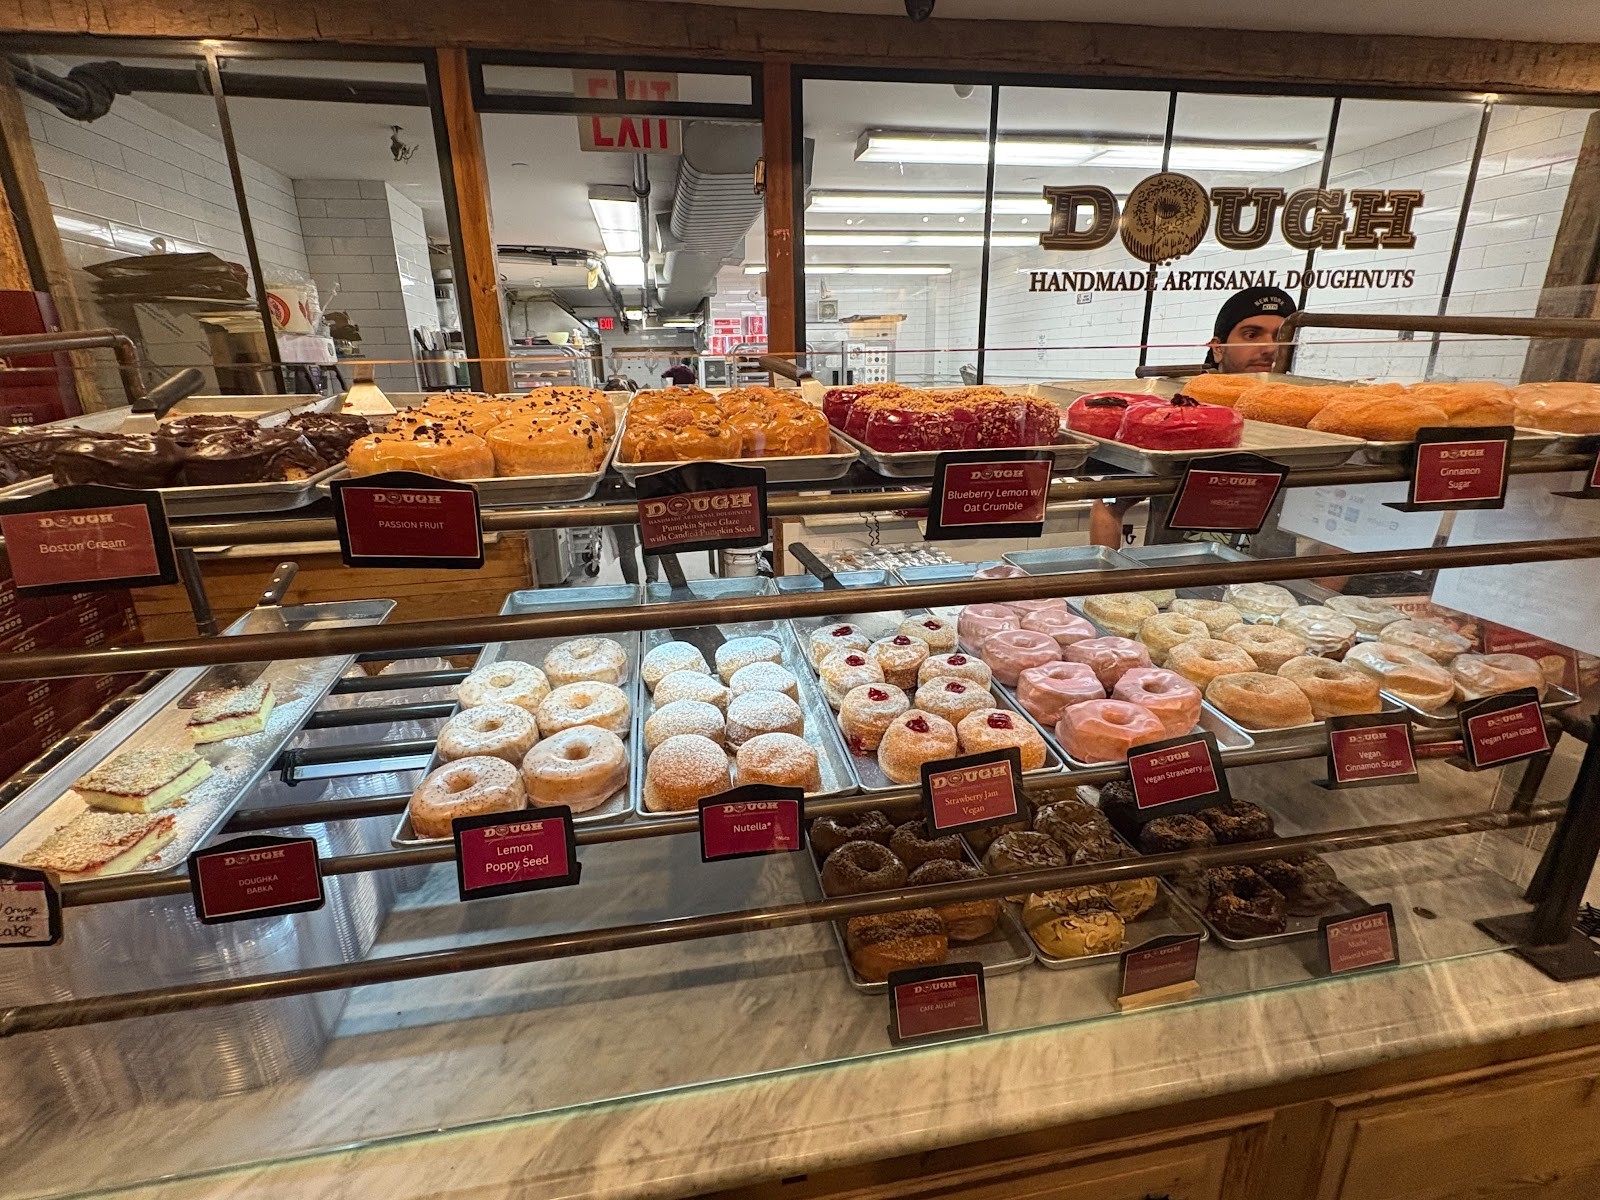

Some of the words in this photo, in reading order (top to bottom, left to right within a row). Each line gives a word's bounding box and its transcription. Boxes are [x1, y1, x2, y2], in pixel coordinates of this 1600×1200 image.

[1039, 172, 1425, 265] DOUGH
[1029, 271, 1158, 292] HANDMADE
[1162, 270, 1281, 291] ARTISANAL
[1284, 269, 1416, 290] DOUGHNUTS
[1254, 297, 1269, 306] NEW
[1270, 296, 1285, 306] YORK
[600, 318, 614, 330] EXIT
[1440, 449, 1485, 459] DOUGH
[970, 469, 1024, 480] DOUGH
[1440, 467, 1481, 477] Cinnamon
[1208, 476, 1258, 486] DOUGH
[1448, 480, 1471, 490] Sugar
[373, 492, 441, 504] DOUGH
[948, 489, 994, 500] Blueberry
[996, 488, 1028, 498] Lemon
[1030, 487, 1043, 497] w/
[644, 492, 753, 518] DOUGH
[963, 503, 980, 512] Oat
[983, 502, 1023, 511] Crumble
[38, 513, 114, 528] DOUGH
[379, 520, 418, 529] PASSION
[420, 521, 444, 530] FRUIT
[662, 522, 697, 533] Pumpkin
[698, 520, 717, 530] Spice
[718, 518, 740, 526] Glaze
[650, 533, 667, 543] with
[668, 530, 699, 541] Candied
[700, 527, 734, 537] Pumpkin
[734, 525, 756, 533] Seeds
[39, 542, 84, 554] Boston
[86, 538, 126, 549] Cream
[1480, 736, 1501, 746] Vegan
[1502, 731, 1519, 741] Plain
[1519, 726, 1537, 736] Glaze
[1359, 751, 1381, 760] Vegan
[1345, 762, 1380, 772] Cinnamon
[1381, 760, 1403, 768] Sugar
[933, 765, 1007, 789] DOUGH
[1144, 773, 1165, 784] Vegan
[1166, 766, 1203, 779] Strawberry
[945, 792, 983, 806] Strawberry
[984, 789, 999, 800] Jam
[723, 801, 779, 814] DOUGH
[963, 805, 985, 816] Vegan
[483, 822, 544, 838] DOUGH
[497, 843, 533, 856] Lemon
[224, 850, 285, 866] DOUGH
[486, 860, 521, 873] Poppy
[523, 854, 549, 868] Seed
[239, 874, 279, 887] DOUGHKA
[247, 884, 273, 895] BABKA
[914, 980, 958, 994] DOUGH
[920, 1004, 934, 1013] CAFE
[944, 1001, 956, 1009] LAIT
